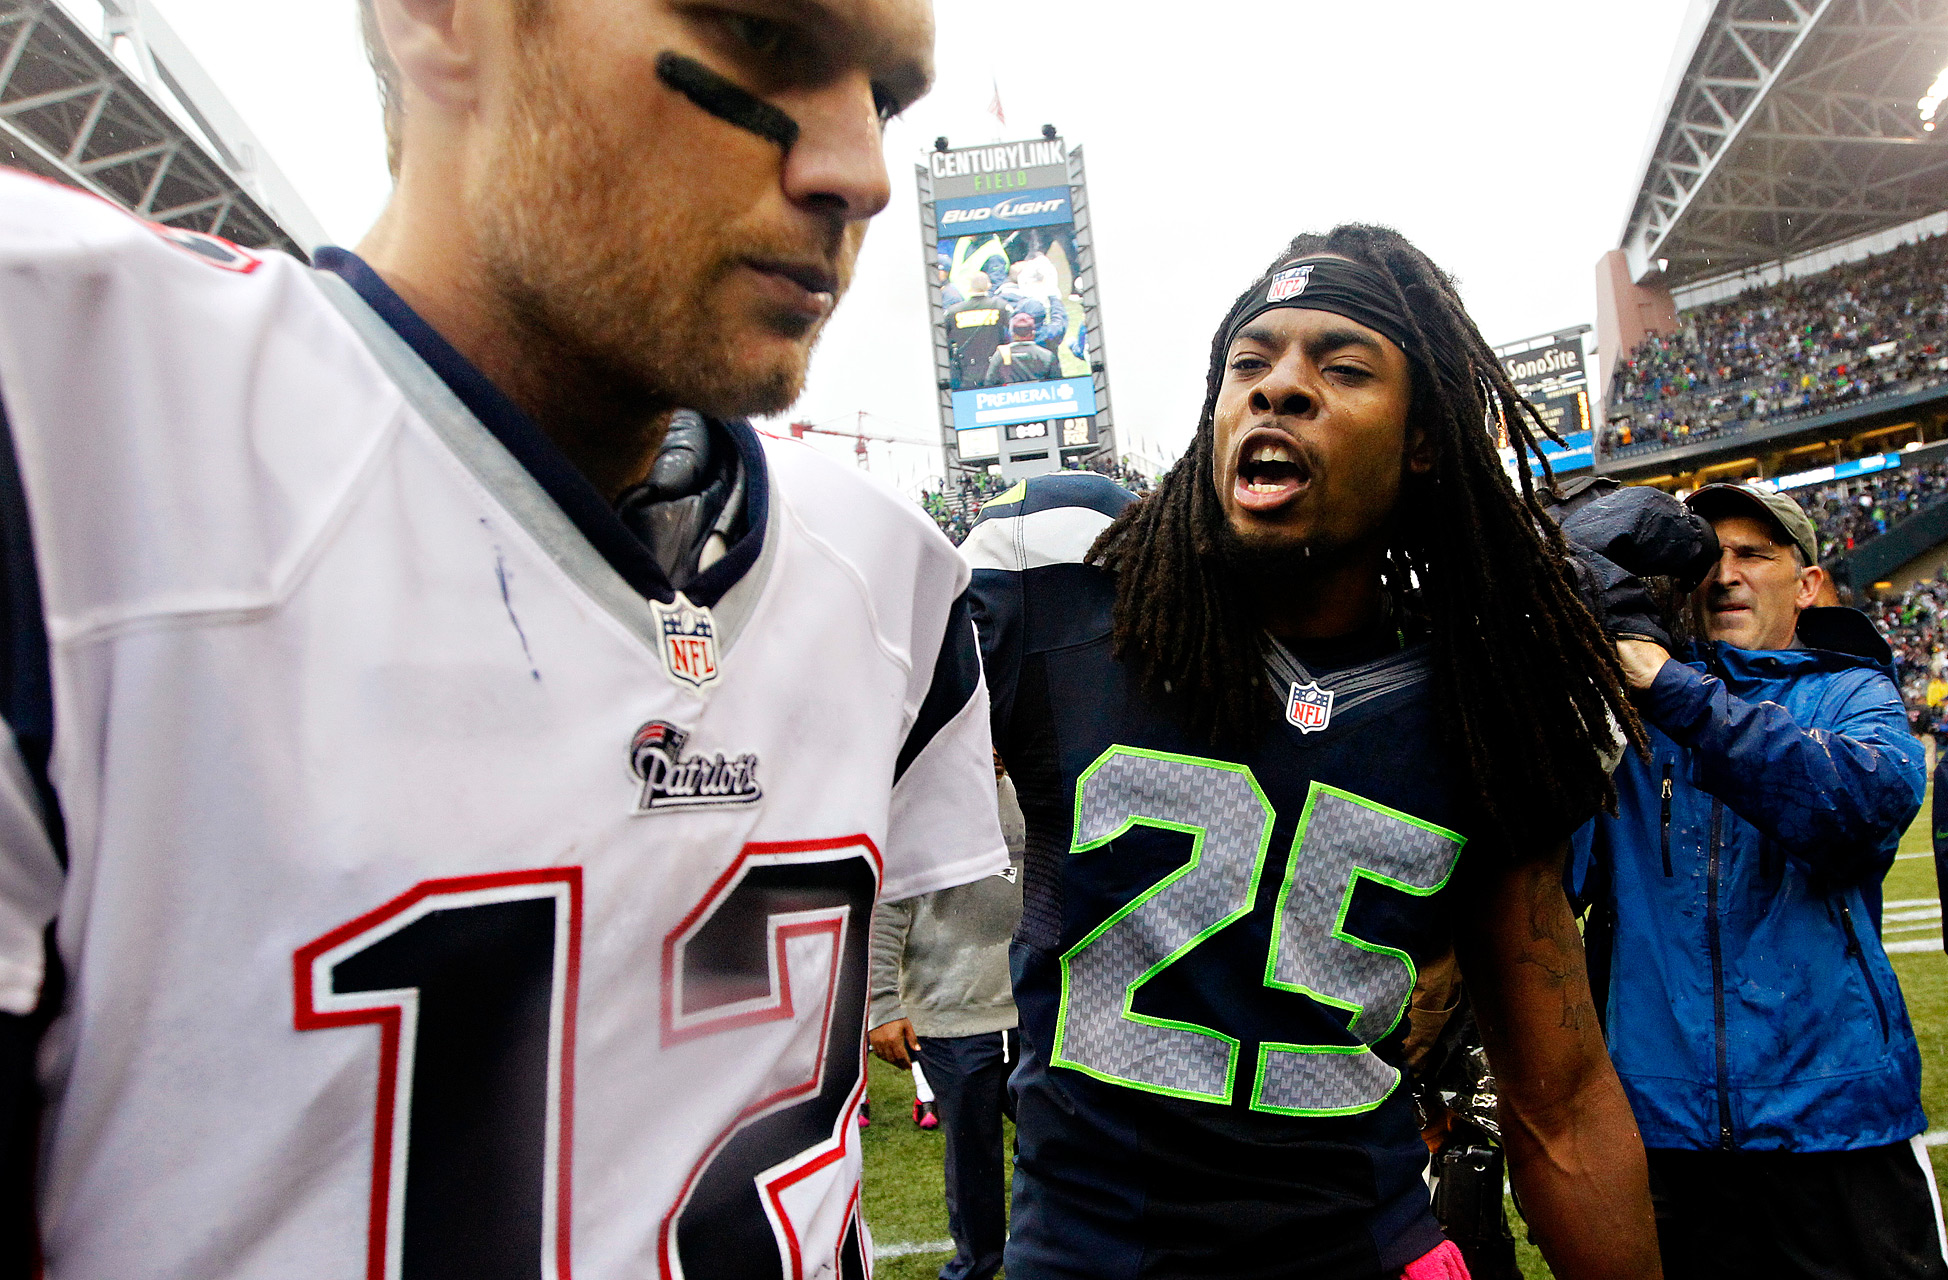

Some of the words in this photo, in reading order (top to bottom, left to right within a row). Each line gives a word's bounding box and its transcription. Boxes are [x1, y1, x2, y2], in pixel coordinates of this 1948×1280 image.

[932, 140, 1065, 178] CENTURYLINK
[974, 171, 1027, 191] FIELD
[1272, 280, 1300, 297] NFL
[1506, 349, 1577, 381] SonoSite
[976, 388, 1051, 409] PREMERA
[671, 639, 714, 677] NFL
[1293, 702, 1322, 725] NFL
[634, 746, 763, 810] Patriots
[1049, 744, 1468, 1117] 25
[293, 833, 883, 1280] 12
